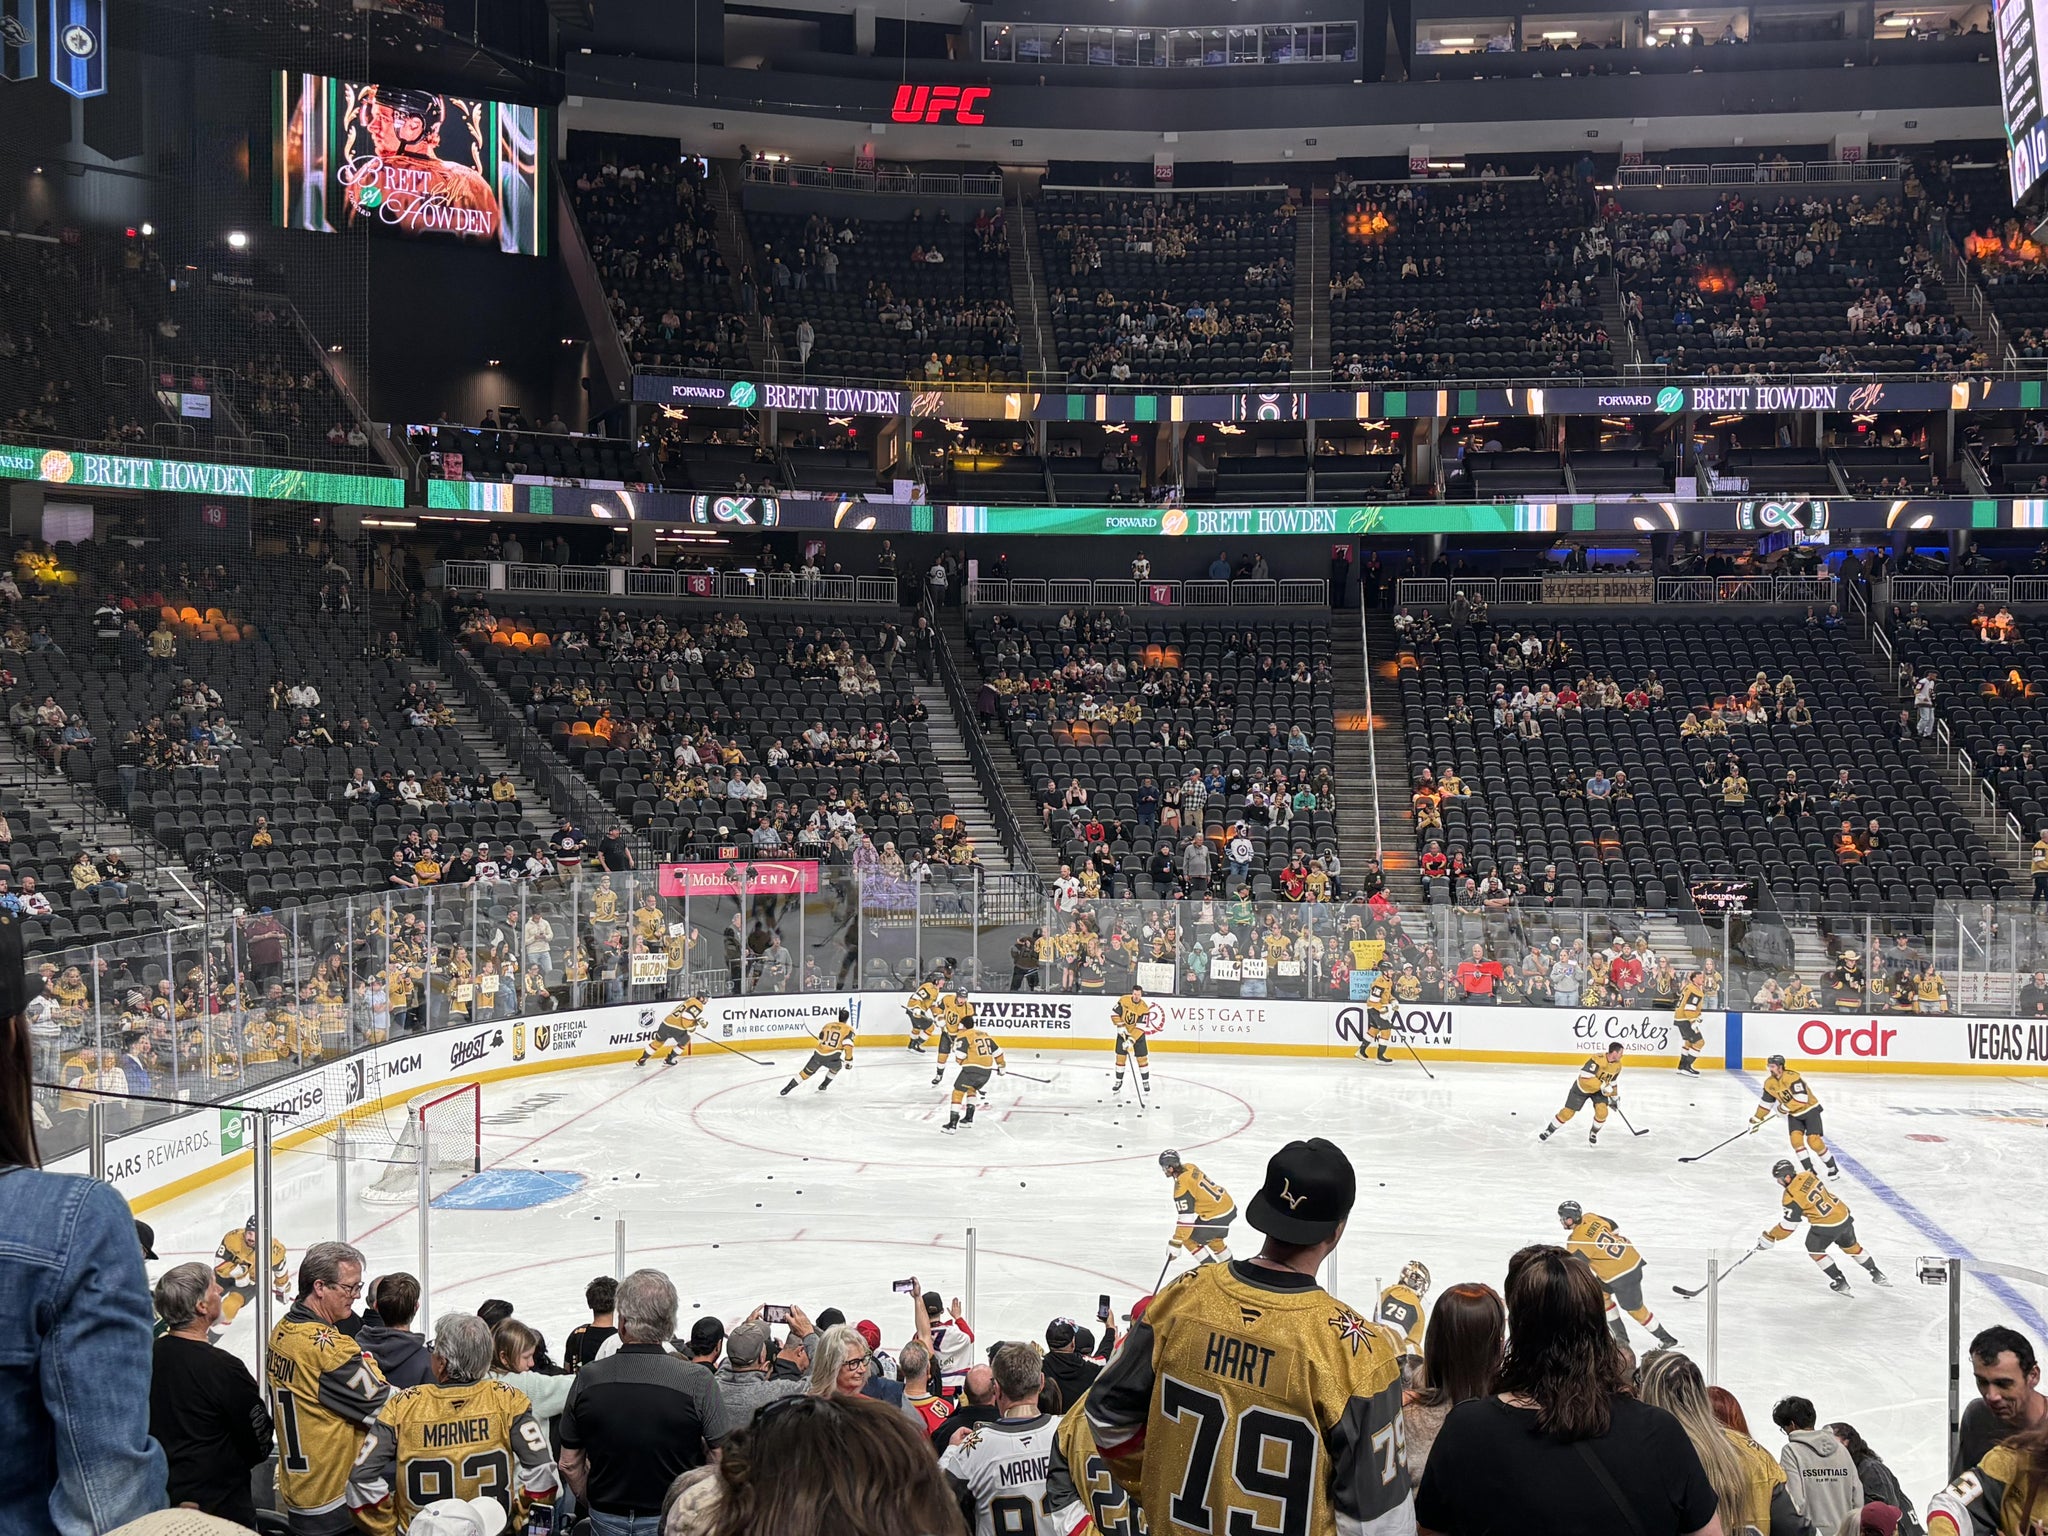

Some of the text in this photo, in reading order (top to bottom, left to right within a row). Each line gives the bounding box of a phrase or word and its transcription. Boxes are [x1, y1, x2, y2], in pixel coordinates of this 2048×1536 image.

[892, 85, 991, 124] UFC
[857, 160, 873, 170] 226
[1156, 168, 1172, 178] 225
[1411, 161, 1427, 170] 224
[337, 155, 432, 194] BRETT
[379, 190, 493, 234] HOWDEN
[212, 272, 253, 286] allegiant
[672, 385, 725, 399] FORWARD
[764, 385, 819, 411] BRETT
[825, 388, 901, 414] HOWDEN
[1598, 394, 1651, 406] FORWARD
[1692, 387, 1749, 410] BRETT
[1756, 386, 1837, 409] HOWDEN
[84, 455, 153, 486] BRETT
[161, 462, 254, 495] HOWDEN
[207, 508, 221, 523] 19
[1105, 517, 1157, 528] FORWARD
[1196, 511, 1251, 534] BRETT
[1258, 509, 1337, 532] HOWDEN
[692, 578, 706, 592] 18
[1557, 583, 1637, 597] VEGAS BORN
[1154, 588, 1167, 601] 17
[722, 849, 735, 859] EXIT
[750, 874, 788, 885] RENA
[1707, 893, 1736, 901] GOLDEN
[633, 962, 668, 977] LAUZON
[722, 1009, 748, 1020] CITY
[750, 1007, 811, 1019] NATIONAL
[1171, 1008, 1266, 1022] WESTGATE
[553, 1020, 588, 1032] OFFICIAL
[766, 1023, 804, 1031] COMPANY
[972, 1018, 1071, 1029] HEADQUARTERS
[1183, 1024, 1251, 1033] LAS VEGAS
[1391, 1010, 1452, 1035] AQVI
[553, 1030, 584, 1041] ENERGY
[609, 1031, 659, 1045] NHLSHO
[821, 1030, 841, 1048] 19
[1573, 1013, 1668, 1050] El Cortez
[1797, 1019, 1897, 1057] Ordr
[451, 1029, 493, 1070] GHOST
[553, 1040, 576, 1051] DRINK
[1576, 1042, 1655, 1051] HOTEL ASINO
[1967, 1023, 2023, 1060] VEGAS
[366, 1053, 422, 1085] BETMGM
[1589, 1063, 1597, 1072] 3
[222, 1087, 324, 1139] enerprise
[107, 1154, 142, 1184] SARS
[1175, 1199, 1188, 1211] 15
[1385, 1302, 1407, 1321] 79
[1204, 1332, 1275, 1388] HART
[277, 1386, 310, 1473] 1
[423, 1417, 490, 1448] MARNER
[519, 1421, 547, 1451] 9
[1160, 1373, 1320, 1536] 79
[1371, 1418, 1408, 1486] 79
[999, 1456, 1050, 1487] MARNE
[1802, 1468, 1848, 1477] ESSENTIALS
[405, 1448, 511, 1514] 93
